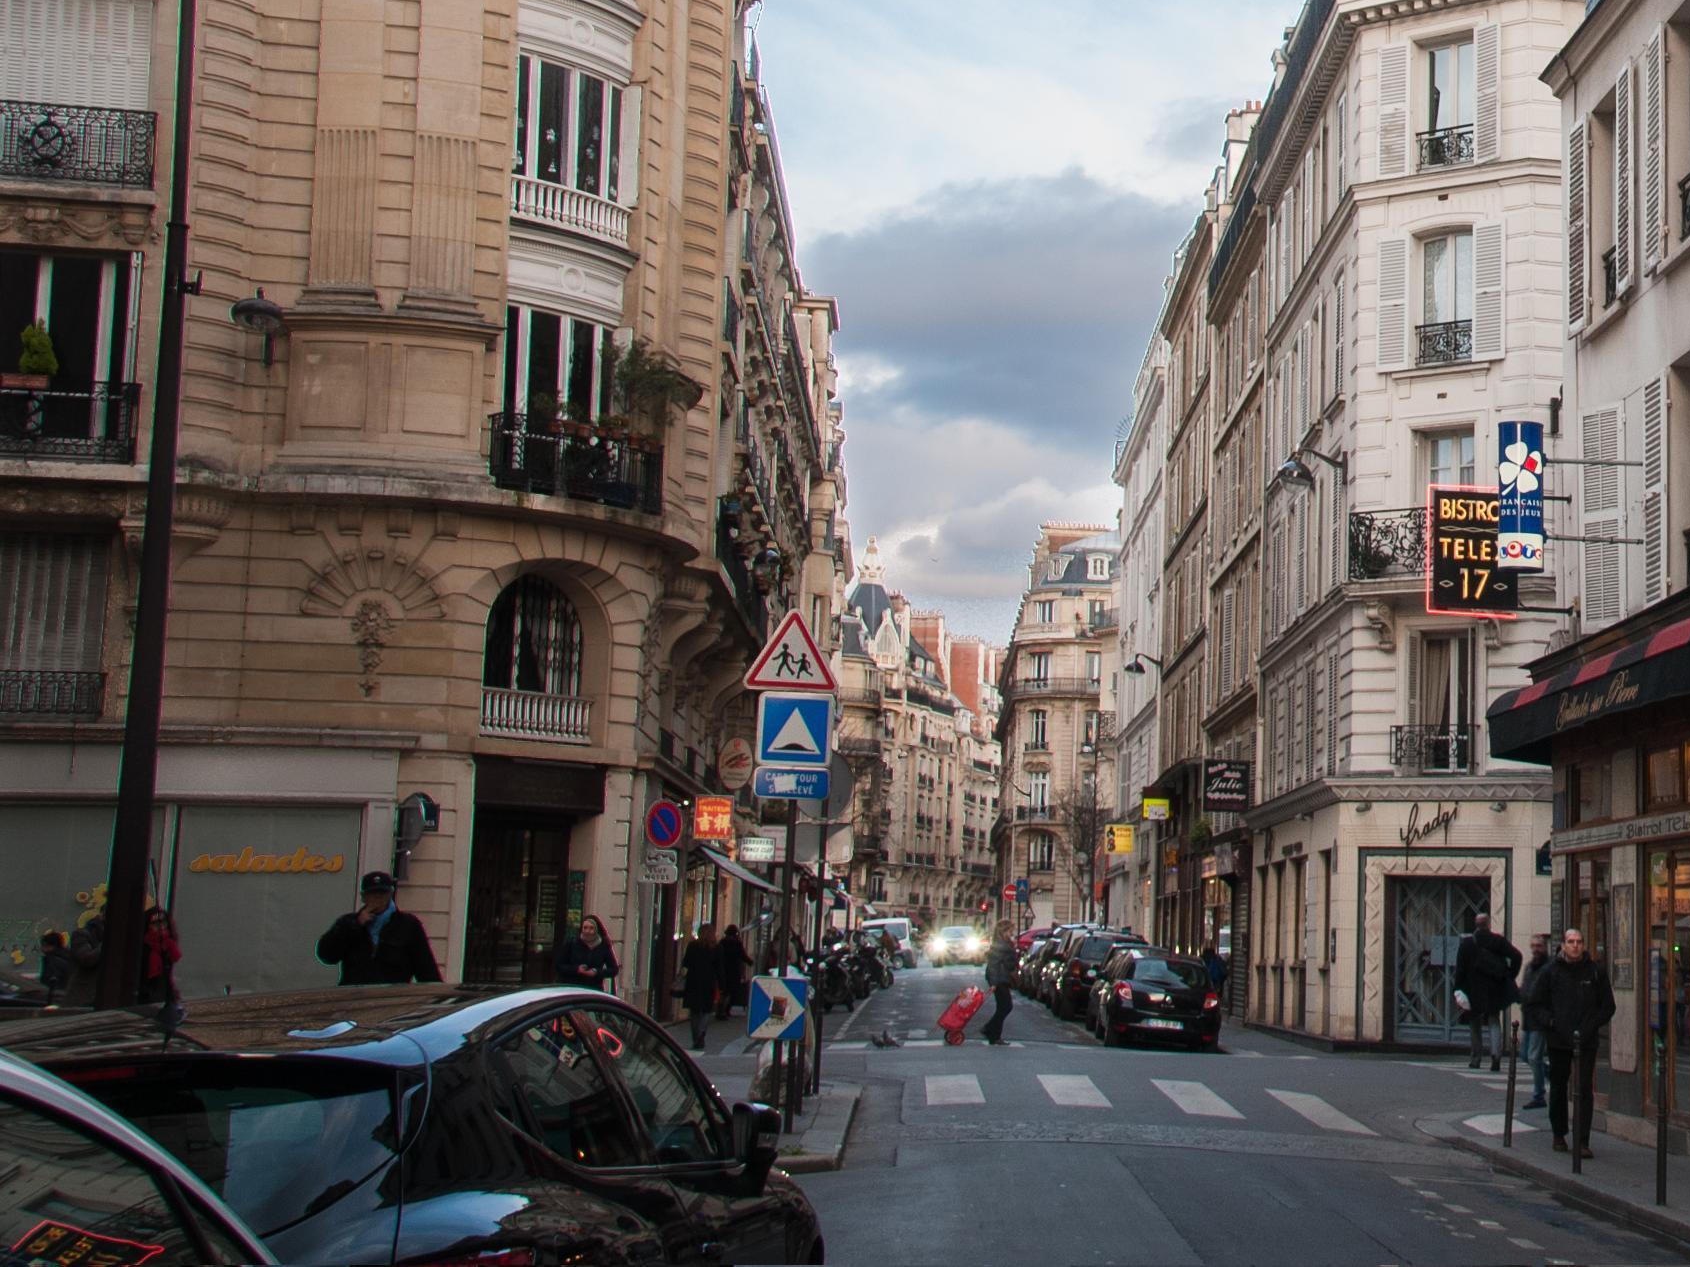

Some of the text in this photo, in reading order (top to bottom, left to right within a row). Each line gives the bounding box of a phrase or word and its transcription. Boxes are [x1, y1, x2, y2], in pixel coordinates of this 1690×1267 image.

[1501, 508, 1541, 517] DES JEUX
[1439, 537, 1498, 561] TELE
[1460, 567, 1491, 600] 17
[189, 846, 344, 872] salades
